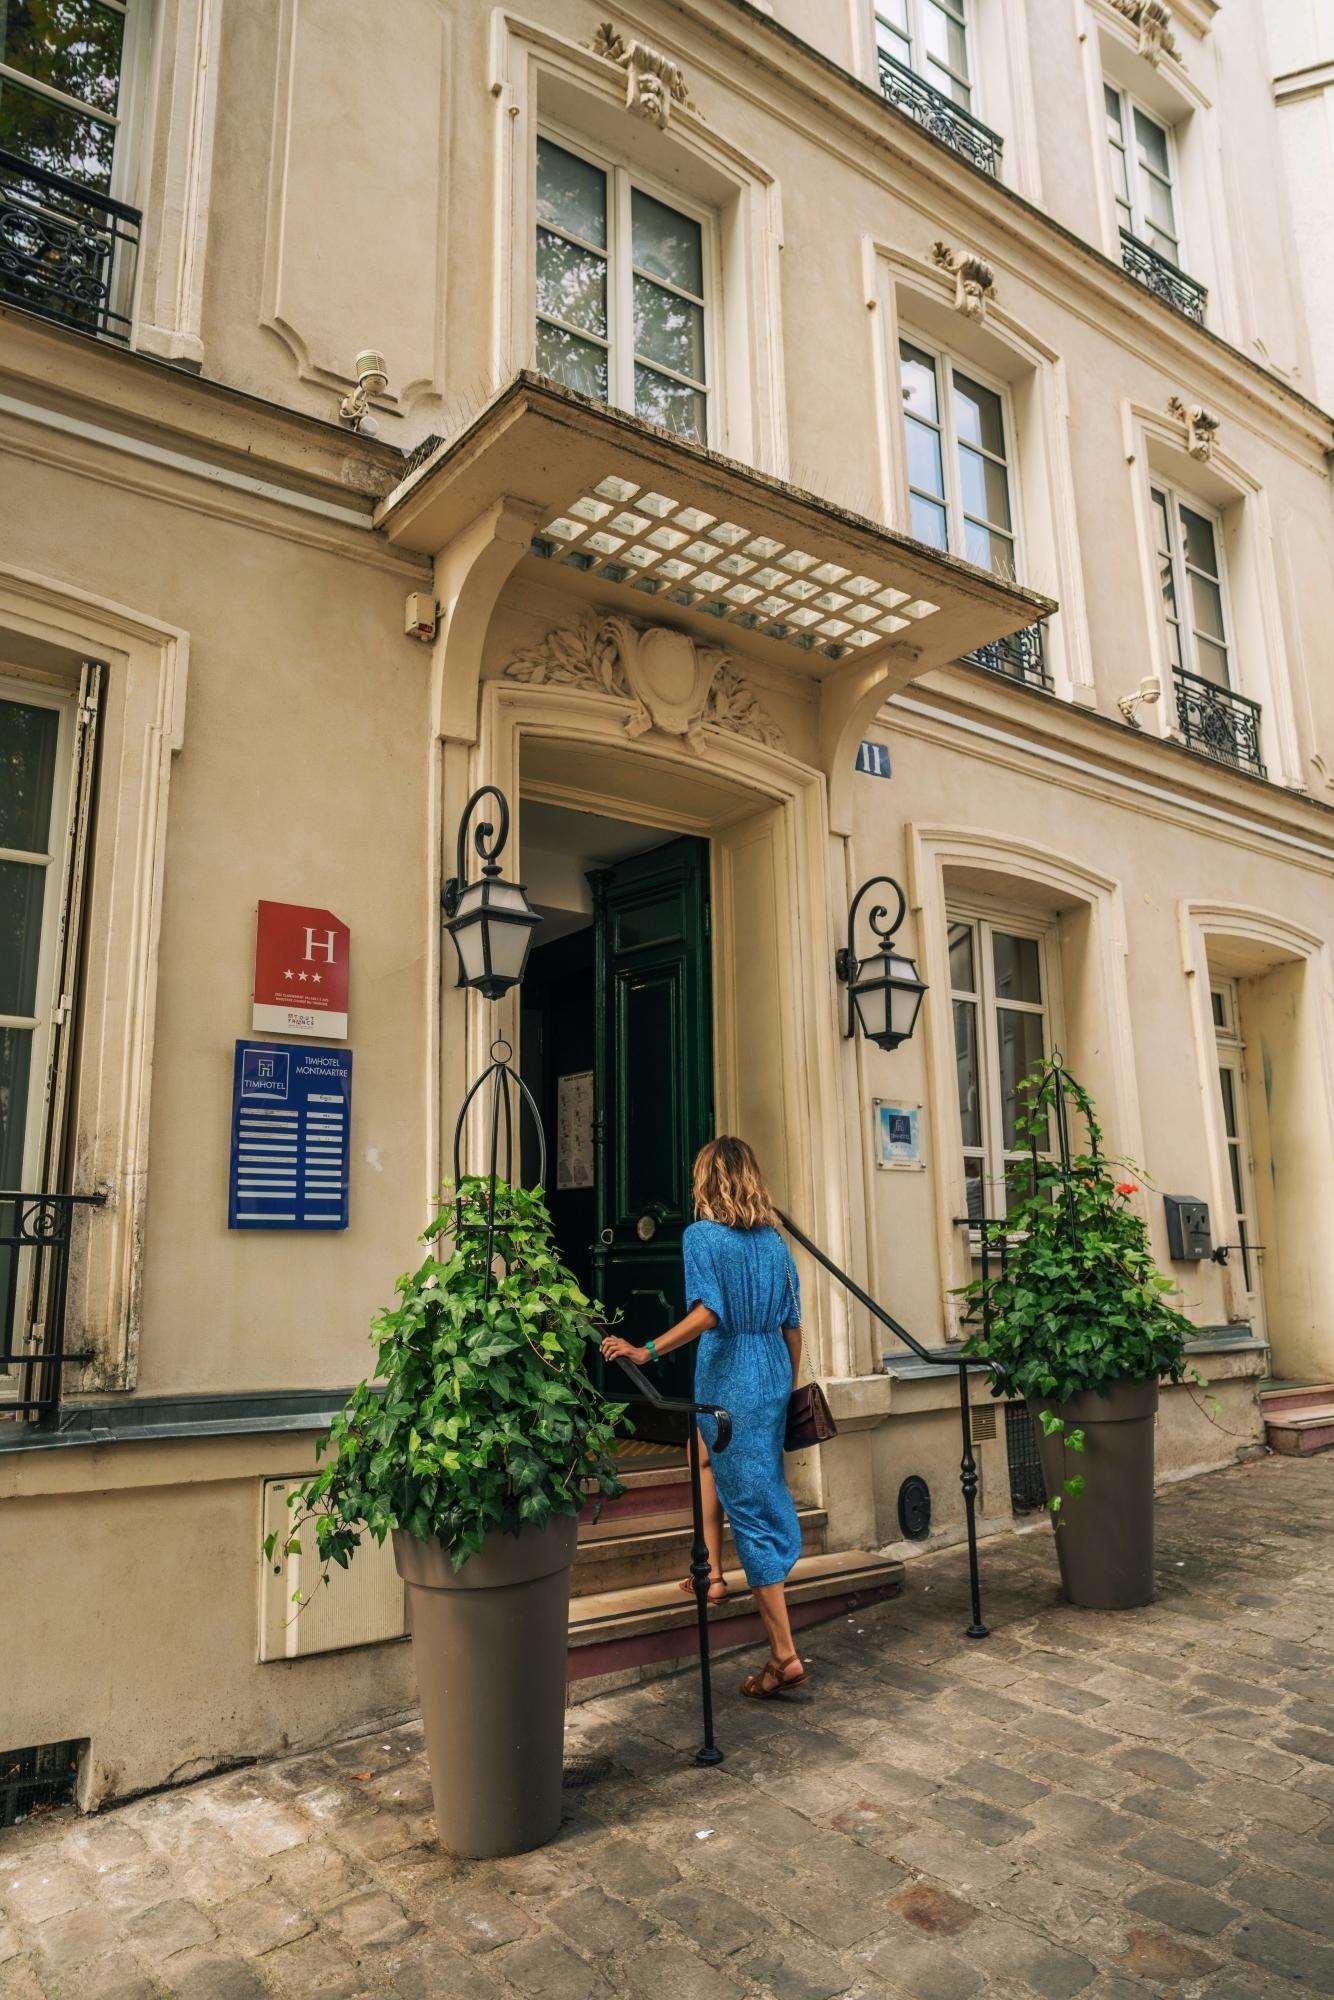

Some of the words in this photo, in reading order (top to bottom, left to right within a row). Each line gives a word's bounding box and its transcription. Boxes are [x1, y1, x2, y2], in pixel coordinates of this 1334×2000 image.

[862, 743, 881, 774] 11
[301, 926, 340, 964] H
[304, 1056, 340, 1067] TIMHOTEL
[296, 1066, 348, 1077] MONTMARTRE
[244, 1079, 286, 1090] TIMHOTEL
